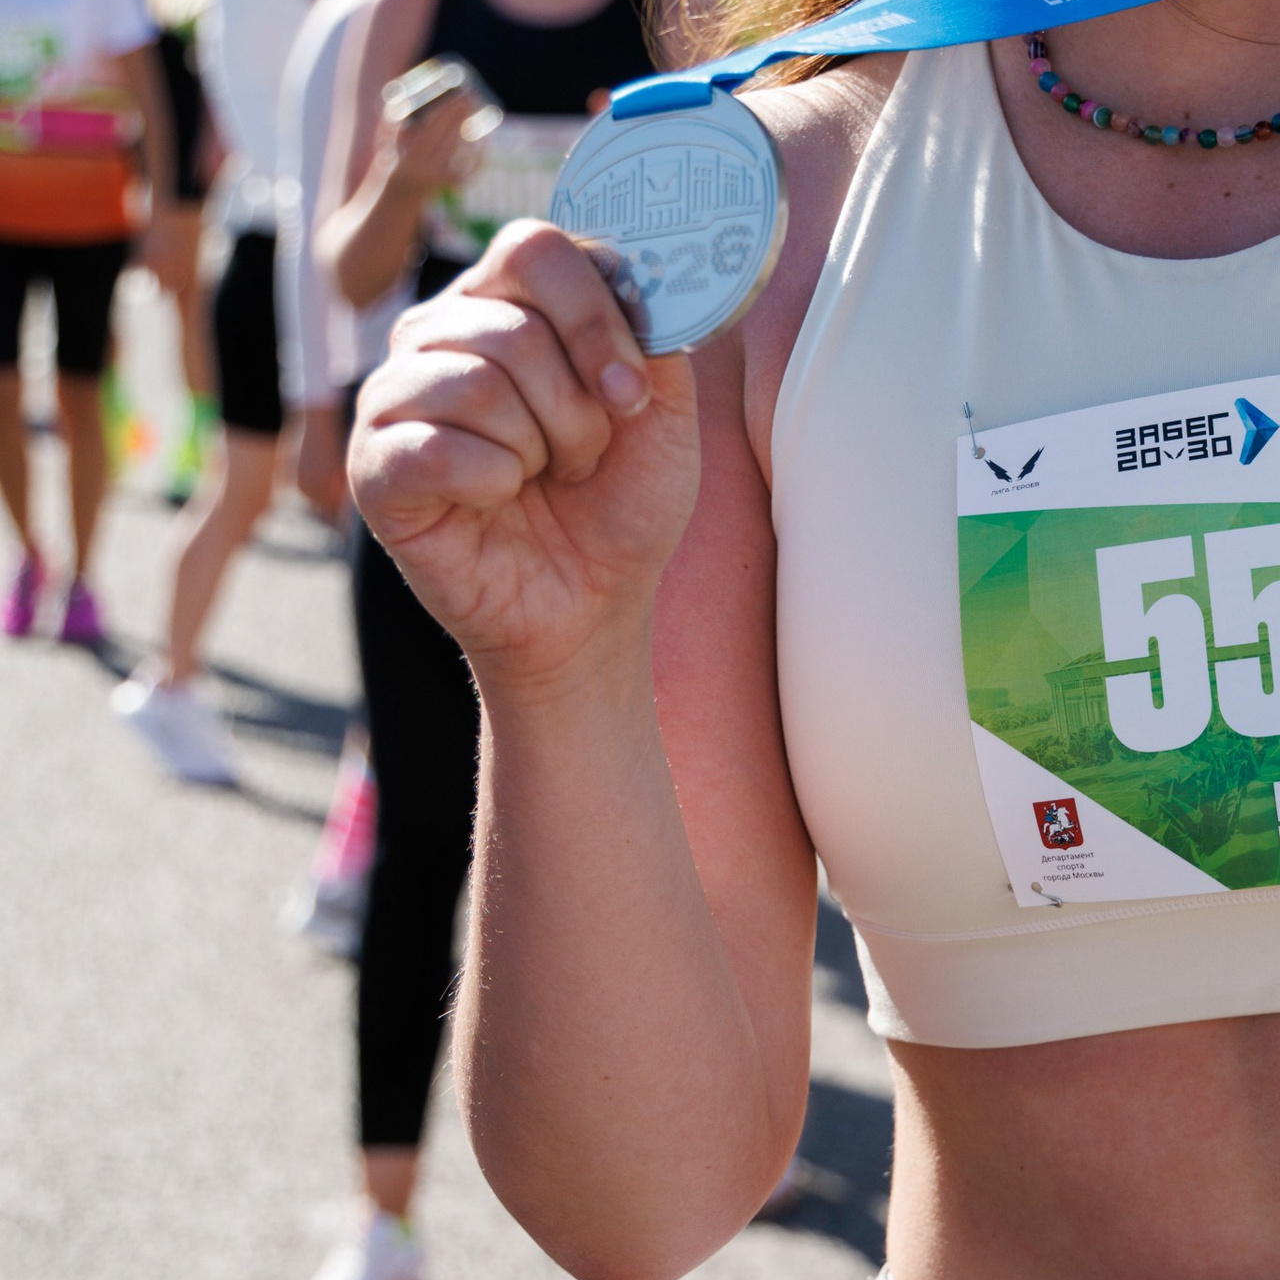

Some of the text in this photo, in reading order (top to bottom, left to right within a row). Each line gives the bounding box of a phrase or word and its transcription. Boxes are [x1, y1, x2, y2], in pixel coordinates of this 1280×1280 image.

[612, 223, 755, 304] 026
[1116, 412, 1229, 450] ЗАБЕГ
[991, 481, 1040, 496] ЛИГА ГЕРОЕВ
[1041, 852, 1095, 863] Департамент
[1056, 863, 1085, 871] спорта
[1043, 871, 1105, 882] города Москвы
